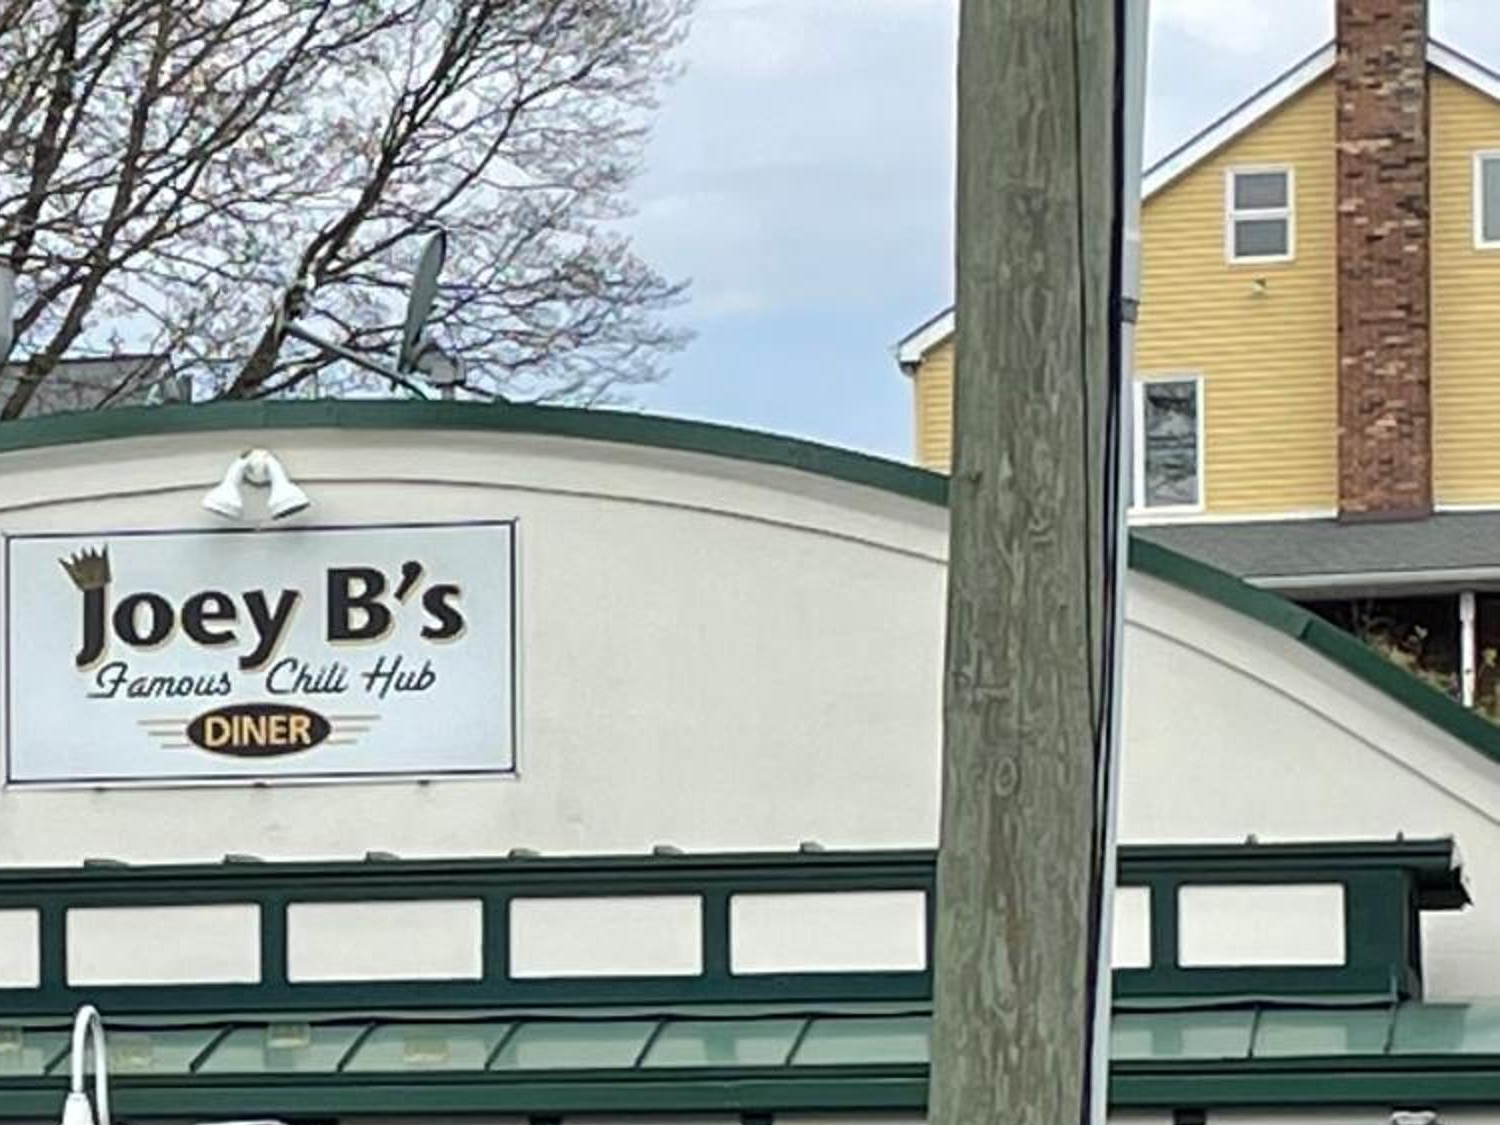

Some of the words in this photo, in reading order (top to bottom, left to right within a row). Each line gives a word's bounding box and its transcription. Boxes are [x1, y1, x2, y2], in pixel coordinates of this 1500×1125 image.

[76, 586, 299, 671] Joey
[328, 561, 464, 643] B's
[87, 661, 233, 699] Famous
[265, 657, 348, 696] Chili
[361, 655, 437, 700] Hub
[203, 714, 313, 748] DINER
